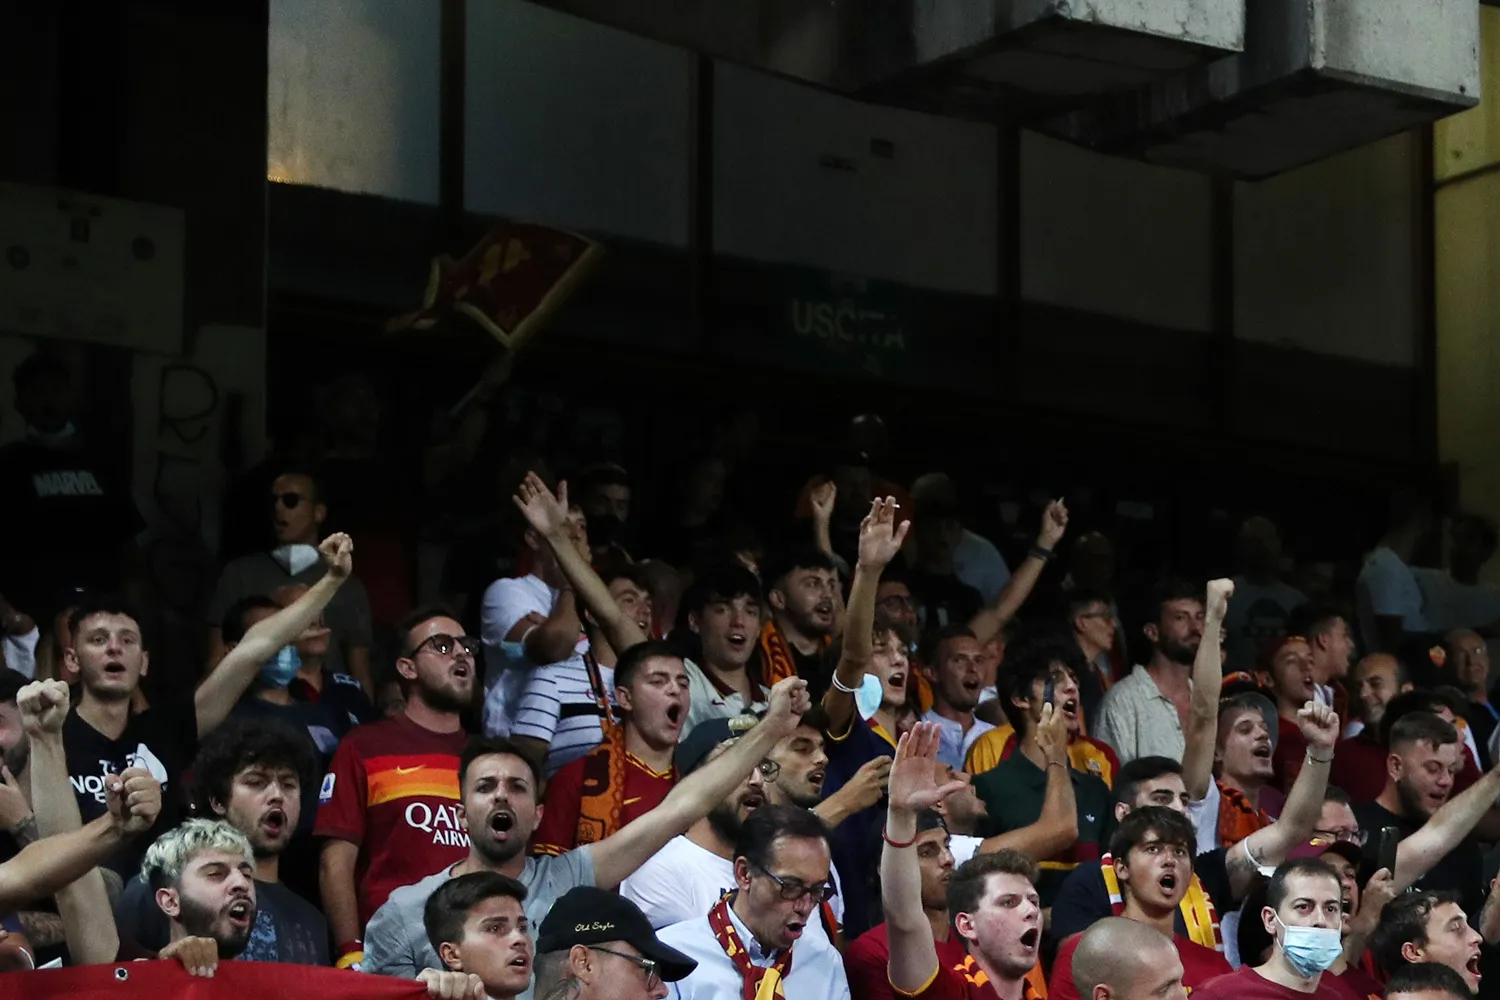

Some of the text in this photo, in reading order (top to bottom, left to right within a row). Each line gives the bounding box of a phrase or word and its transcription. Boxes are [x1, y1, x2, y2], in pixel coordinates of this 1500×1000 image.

[33, 471, 102, 496] MARVEL
[405, 802, 462, 832] QAT
[433, 829, 471, 847] AIRW
